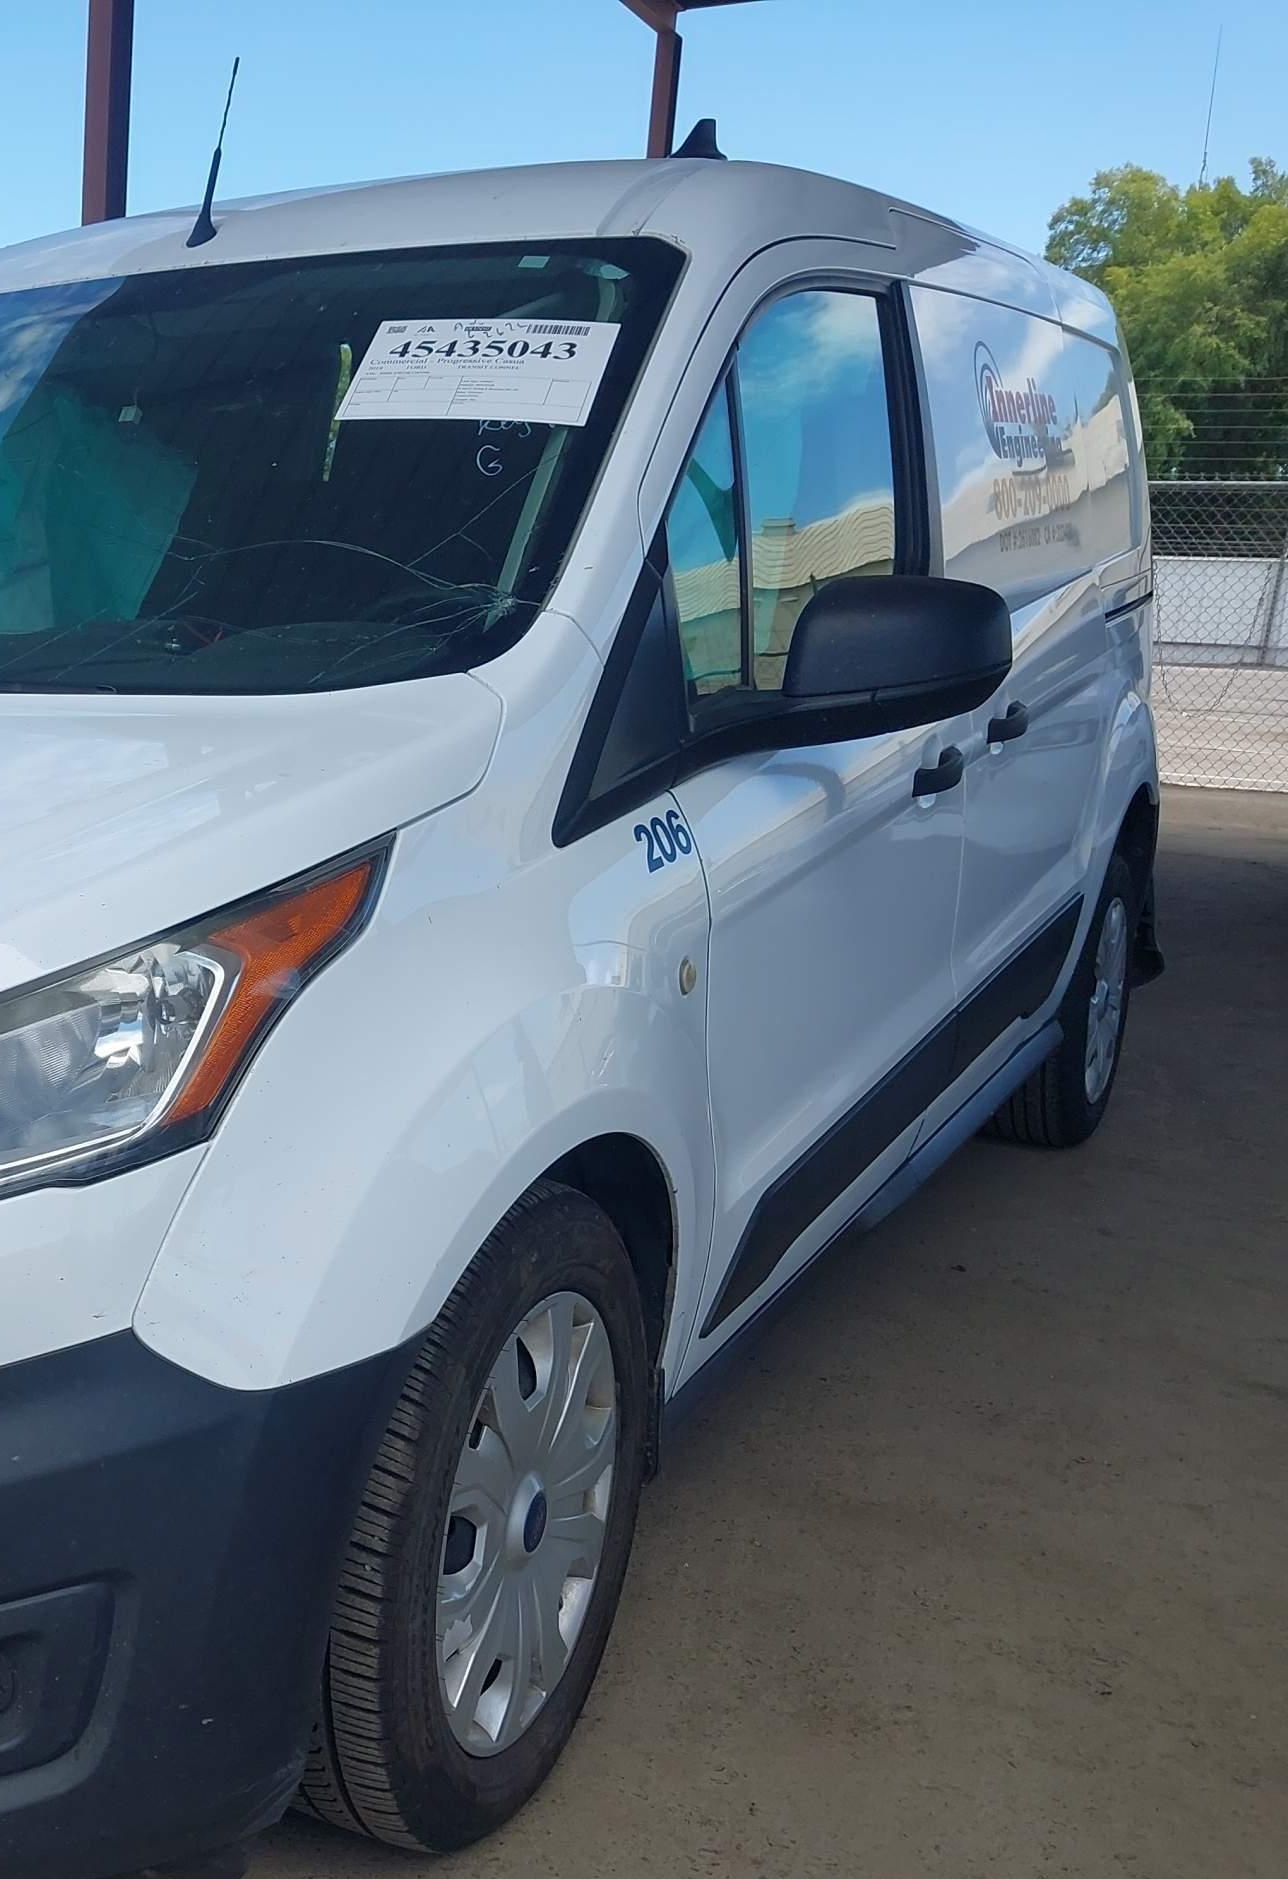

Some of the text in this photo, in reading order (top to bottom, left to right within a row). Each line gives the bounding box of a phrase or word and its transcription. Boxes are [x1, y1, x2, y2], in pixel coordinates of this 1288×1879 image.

[389, 339, 577, 360] 45435043
[437, 358, 492, 366] Progressive
[633, 809, 692, 873] 206
